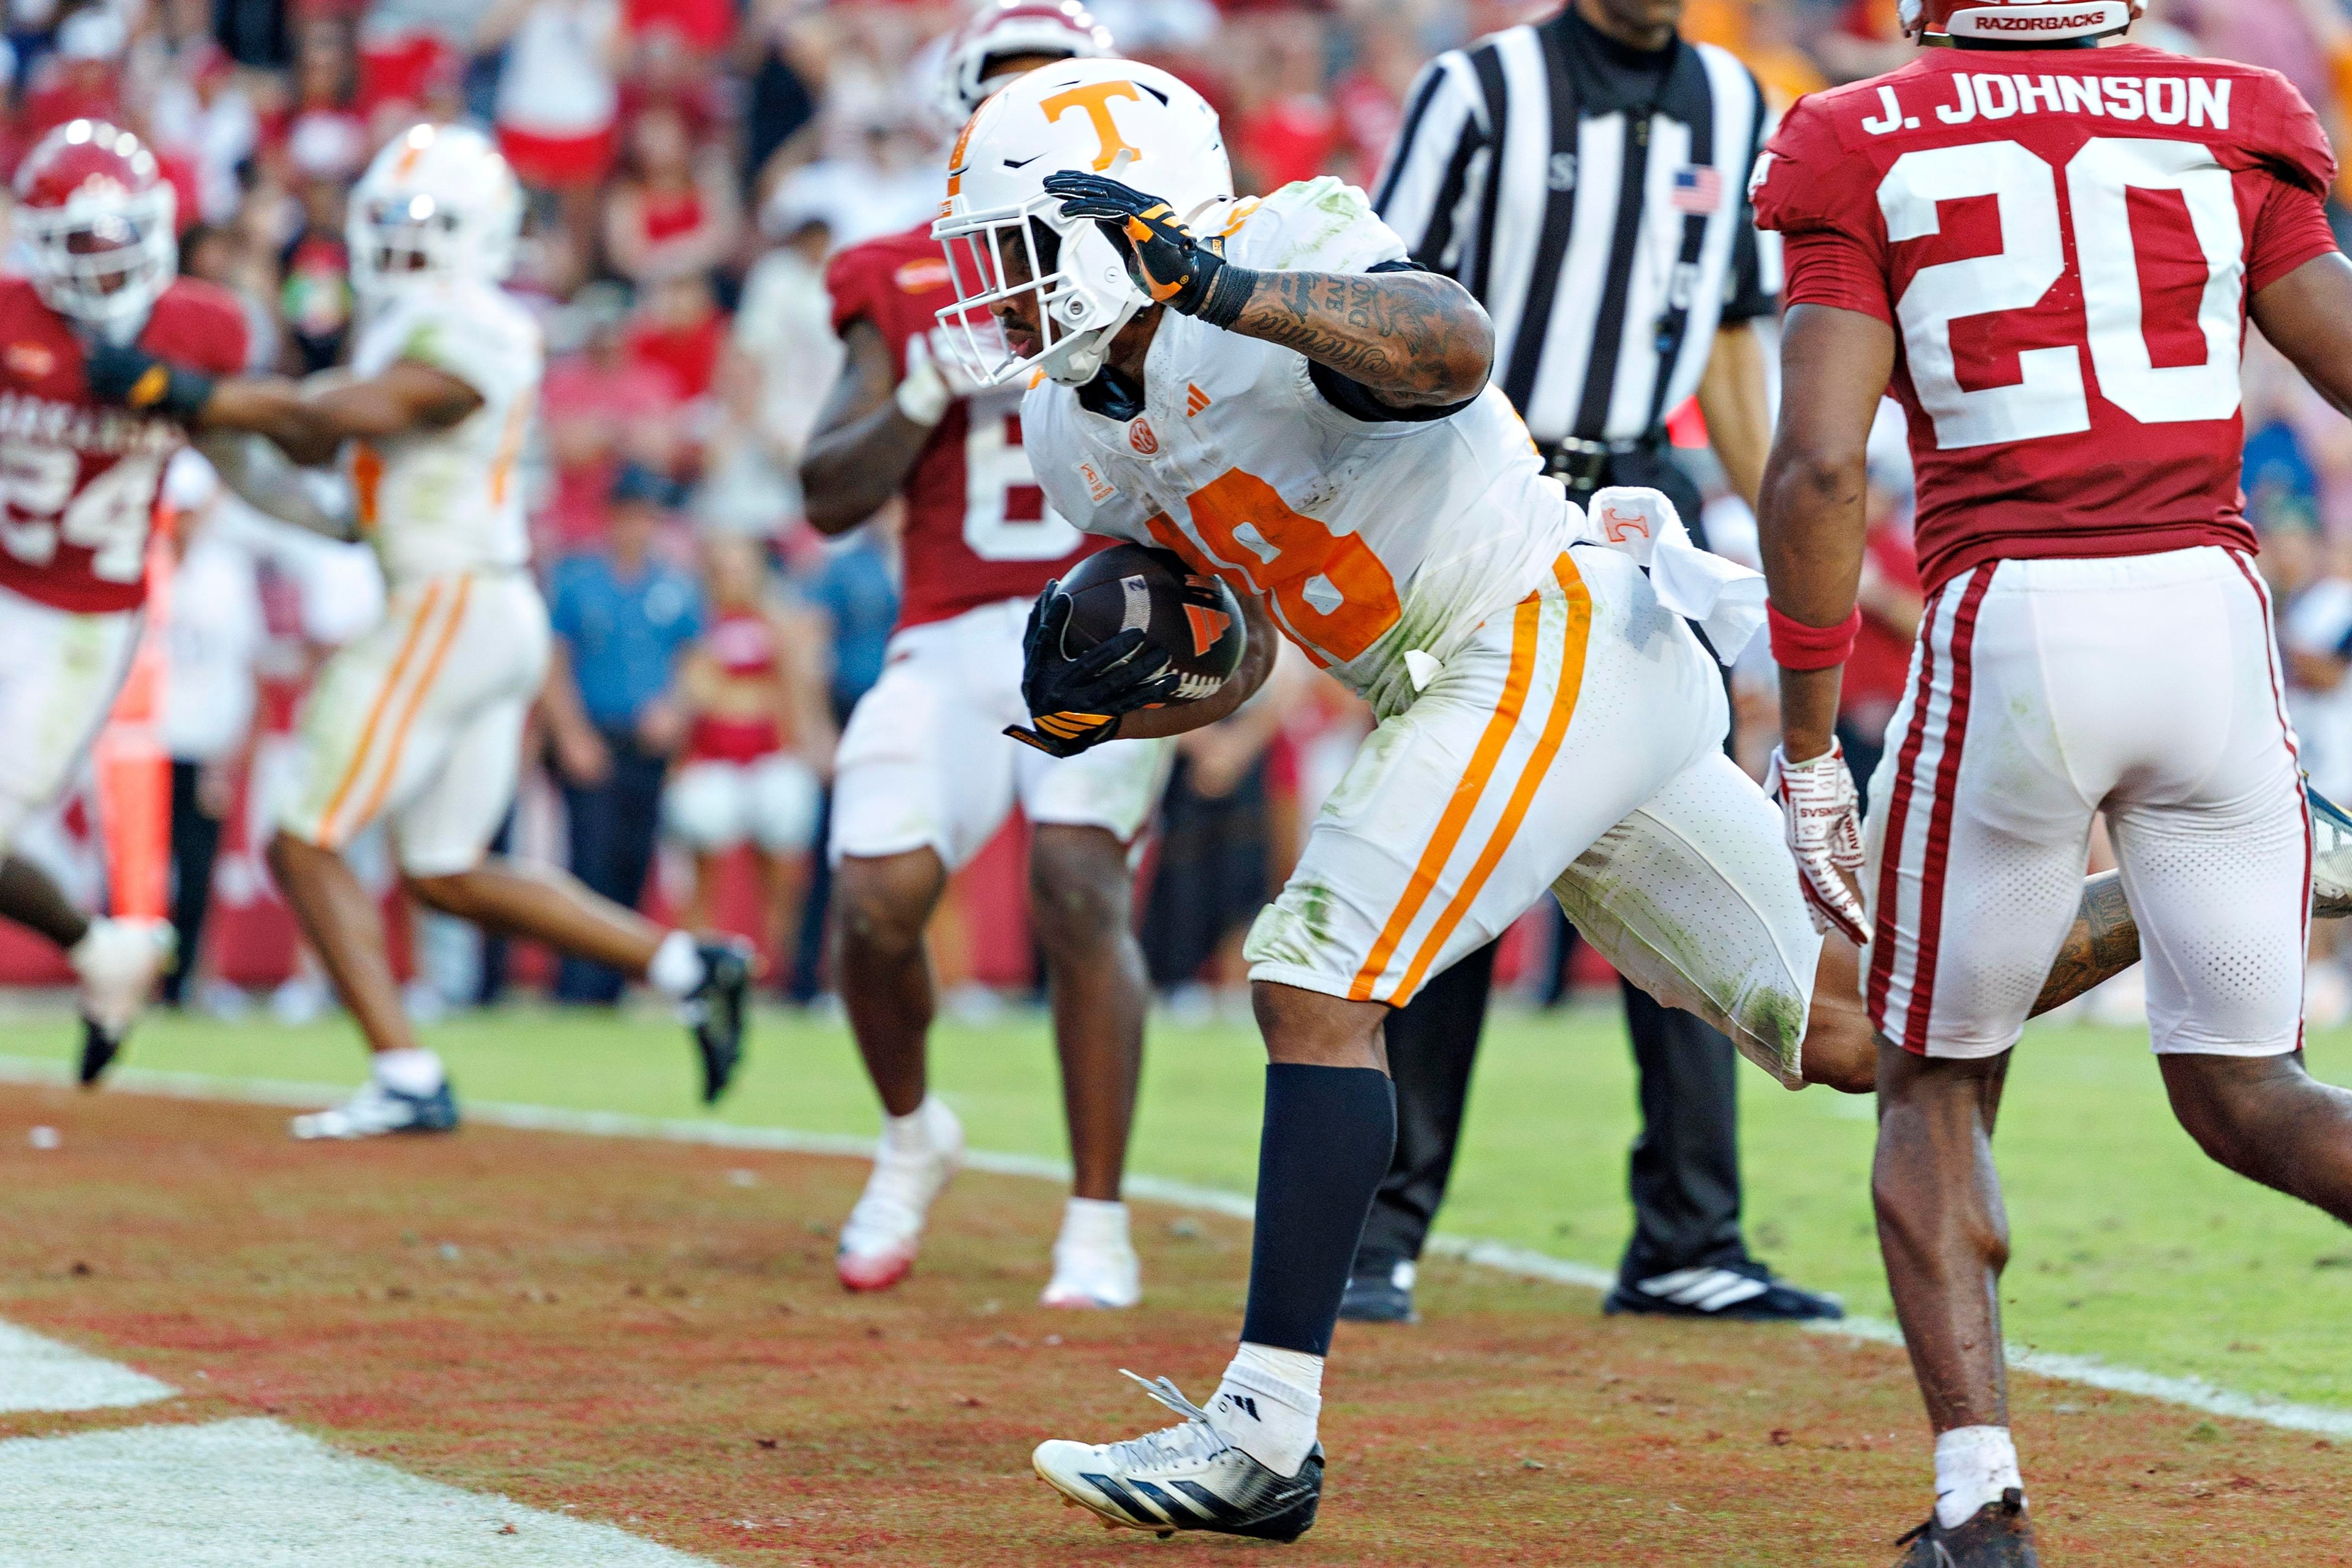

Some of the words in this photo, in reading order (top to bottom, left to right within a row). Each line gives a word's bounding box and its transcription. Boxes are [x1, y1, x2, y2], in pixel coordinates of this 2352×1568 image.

[1975, 11, 2105, 31] RAZORBACKS
[1039, 80, 1142, 172] T
[1861, 85, 1921, 136] J.
[1937, 72, 2232, 130] JOHNSON
[1876, 137, 2245, 450] 20
